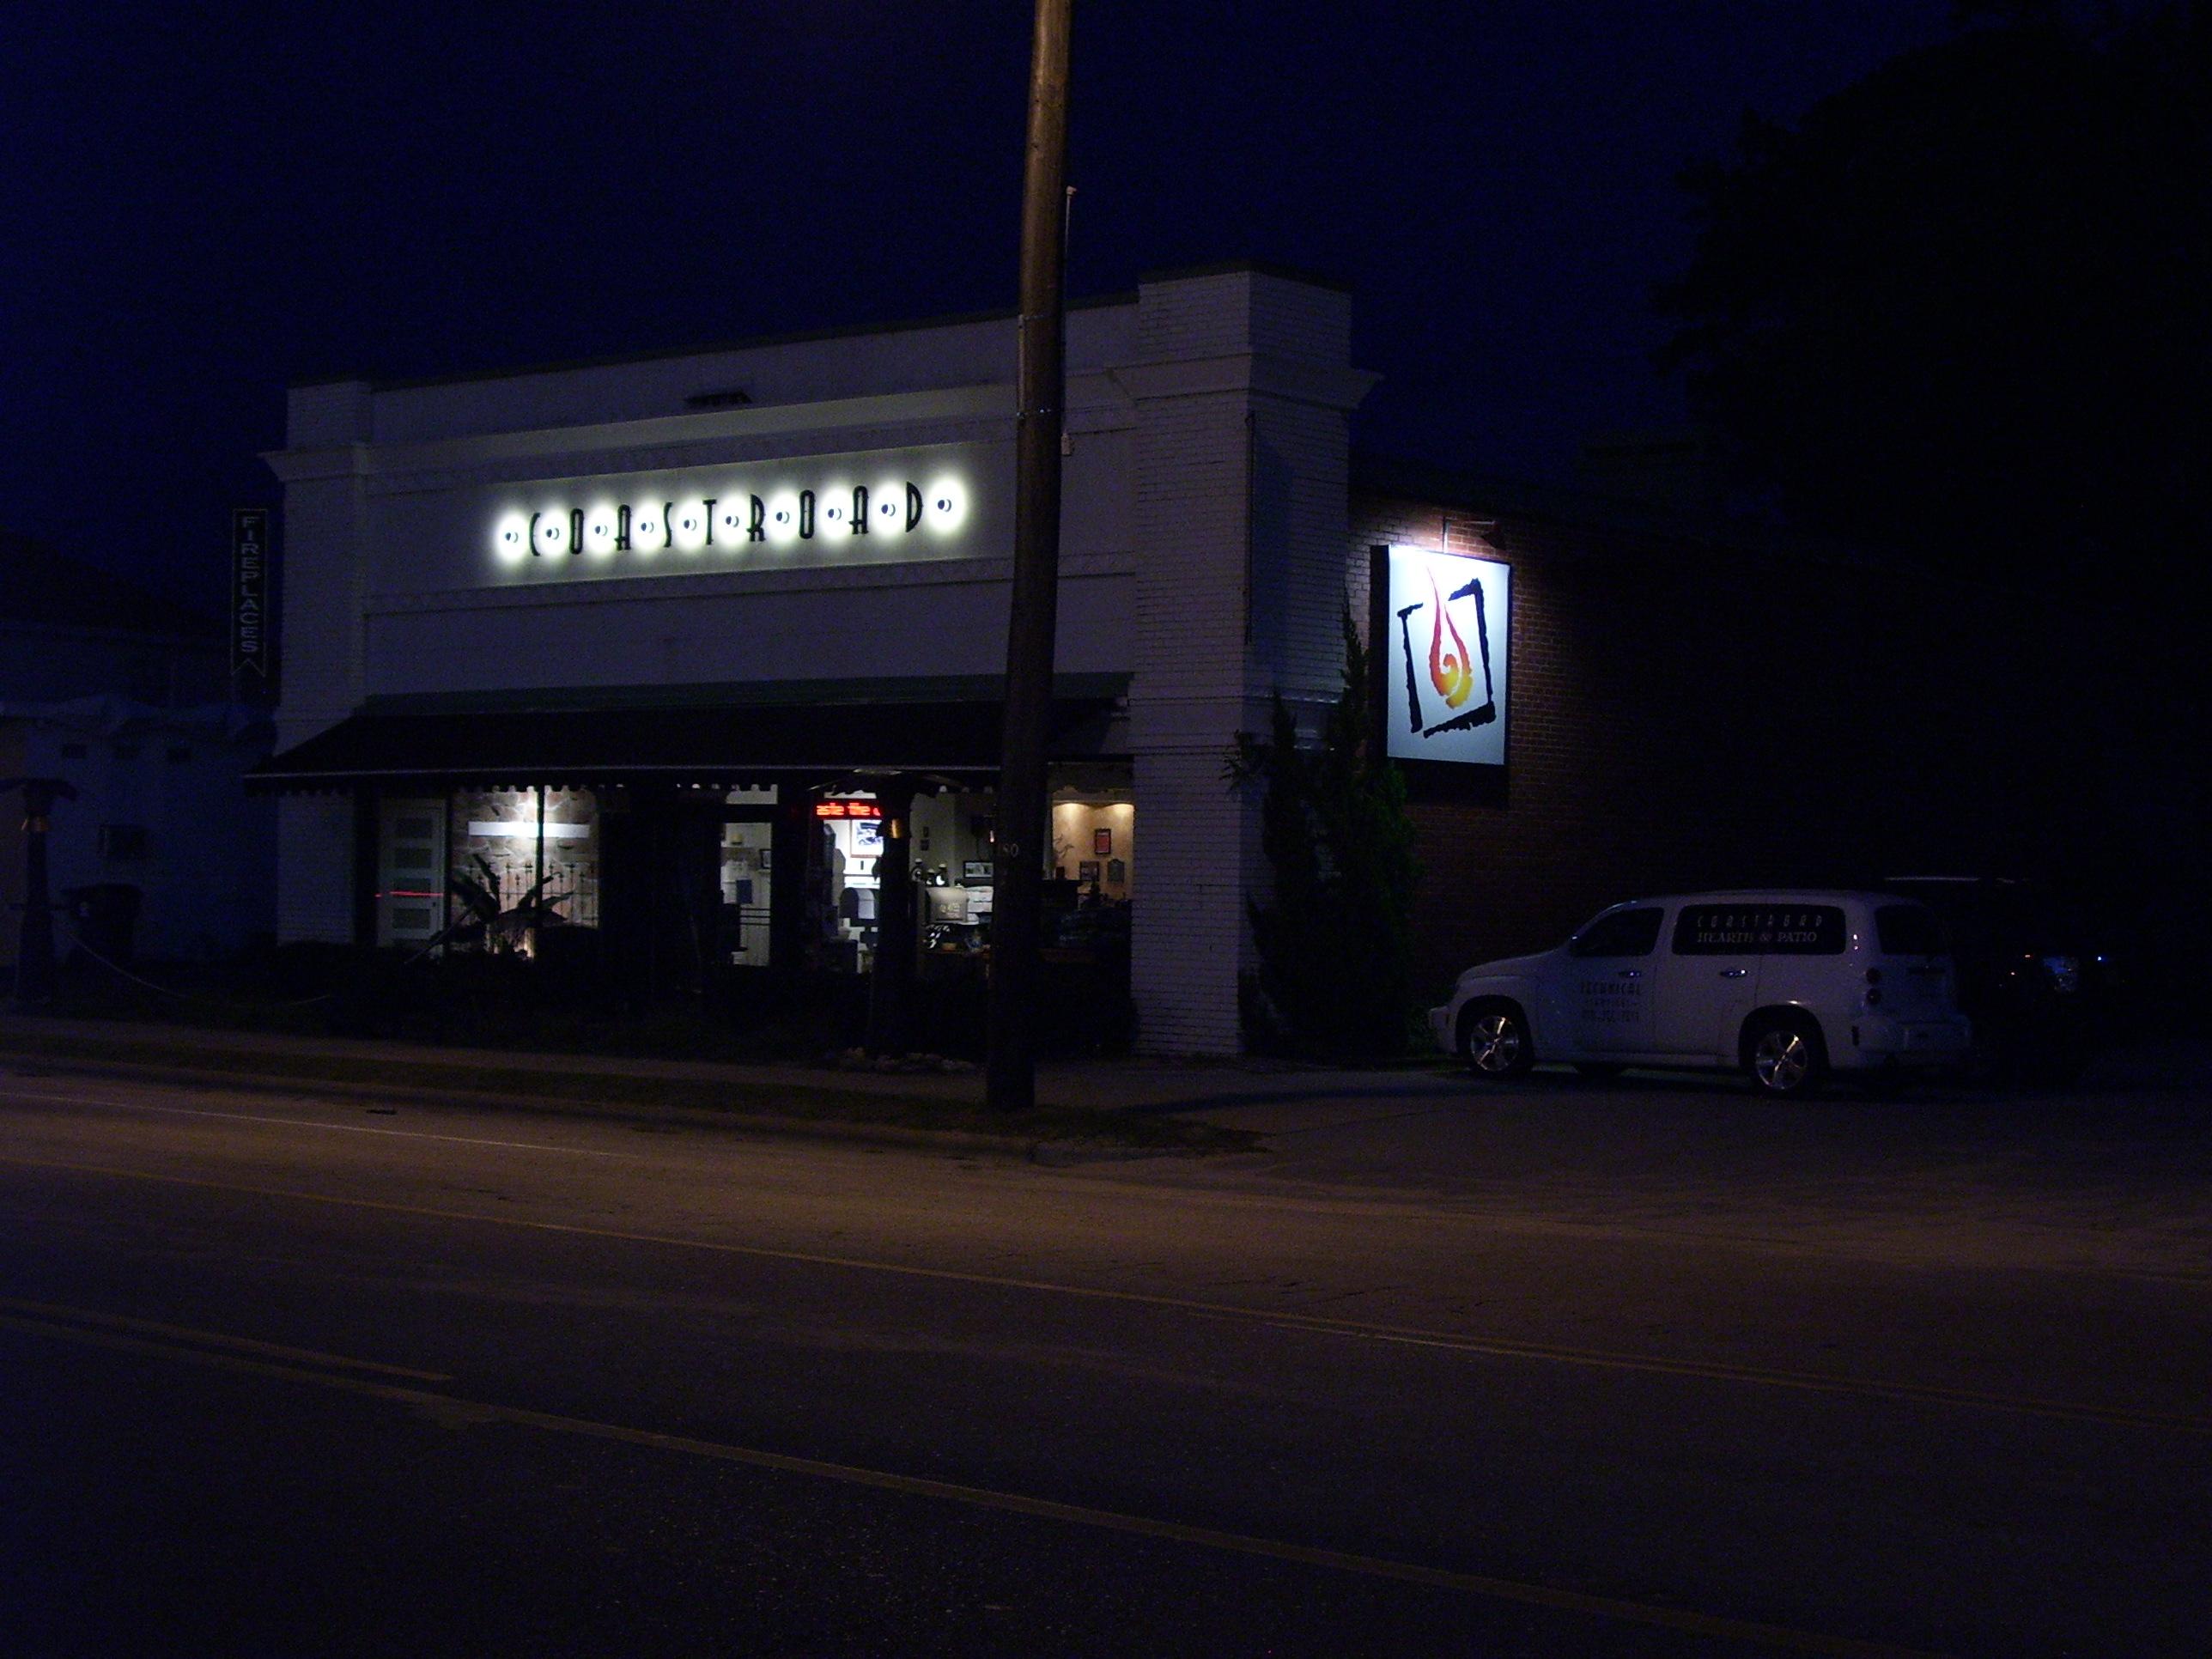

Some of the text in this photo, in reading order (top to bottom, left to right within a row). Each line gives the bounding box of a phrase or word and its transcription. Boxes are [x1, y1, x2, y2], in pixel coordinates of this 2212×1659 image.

[238, 515, 260, 653] FIREPLACES
[1697, 931, 1818, 943] HEARTH & PATIO
